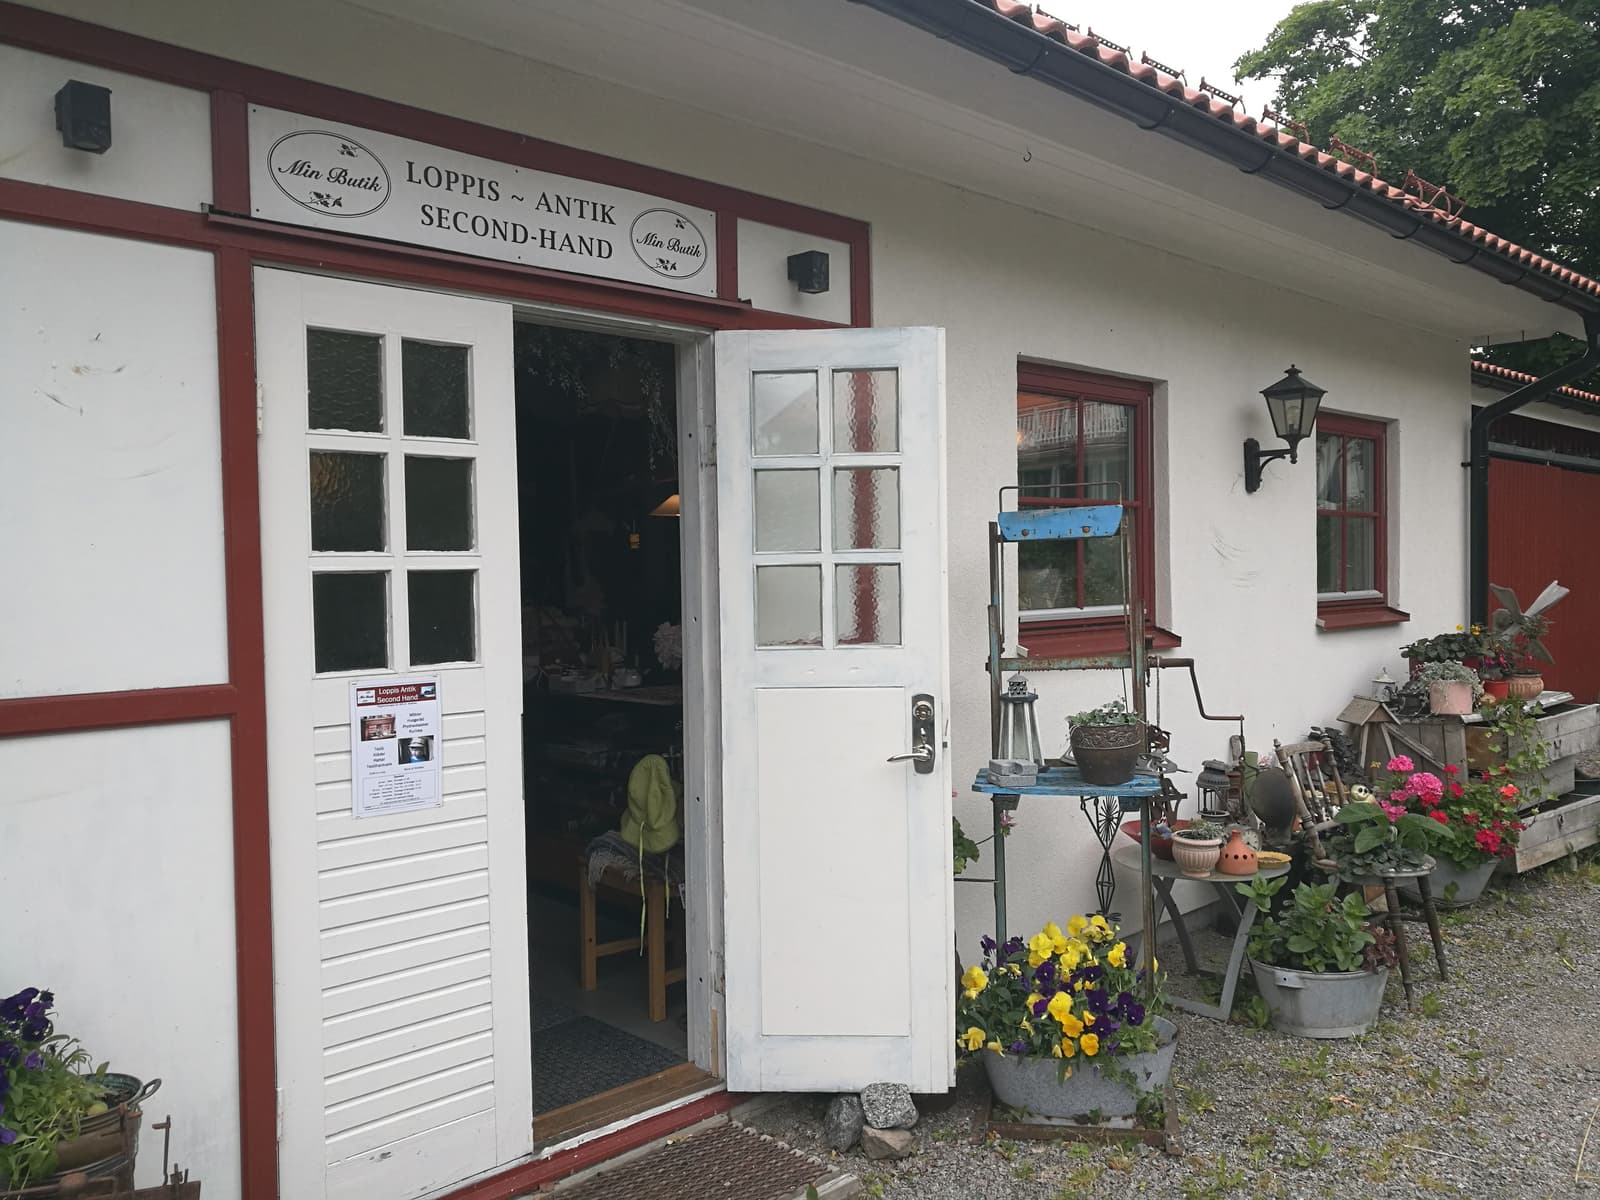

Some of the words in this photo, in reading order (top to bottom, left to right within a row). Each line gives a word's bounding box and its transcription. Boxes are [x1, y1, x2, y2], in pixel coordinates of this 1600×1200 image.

[277, 159, 323, 180] Min
[326, 167, 382, 192] Butik
[405, 160, 500, 202] LOPPIS
[534, 191, 617, 226] ANTIK
[420, 203, 614, 260] SECOND-HAND
[636, 232, 664, 249] Min
[666, 237, 702, 258] Butik
[377, 694, 401, 704] Second
[401, 693, 419, 702] Hand
[378, 686, 400, 696] Loppis
[400, 685, 417, 694] Antik
